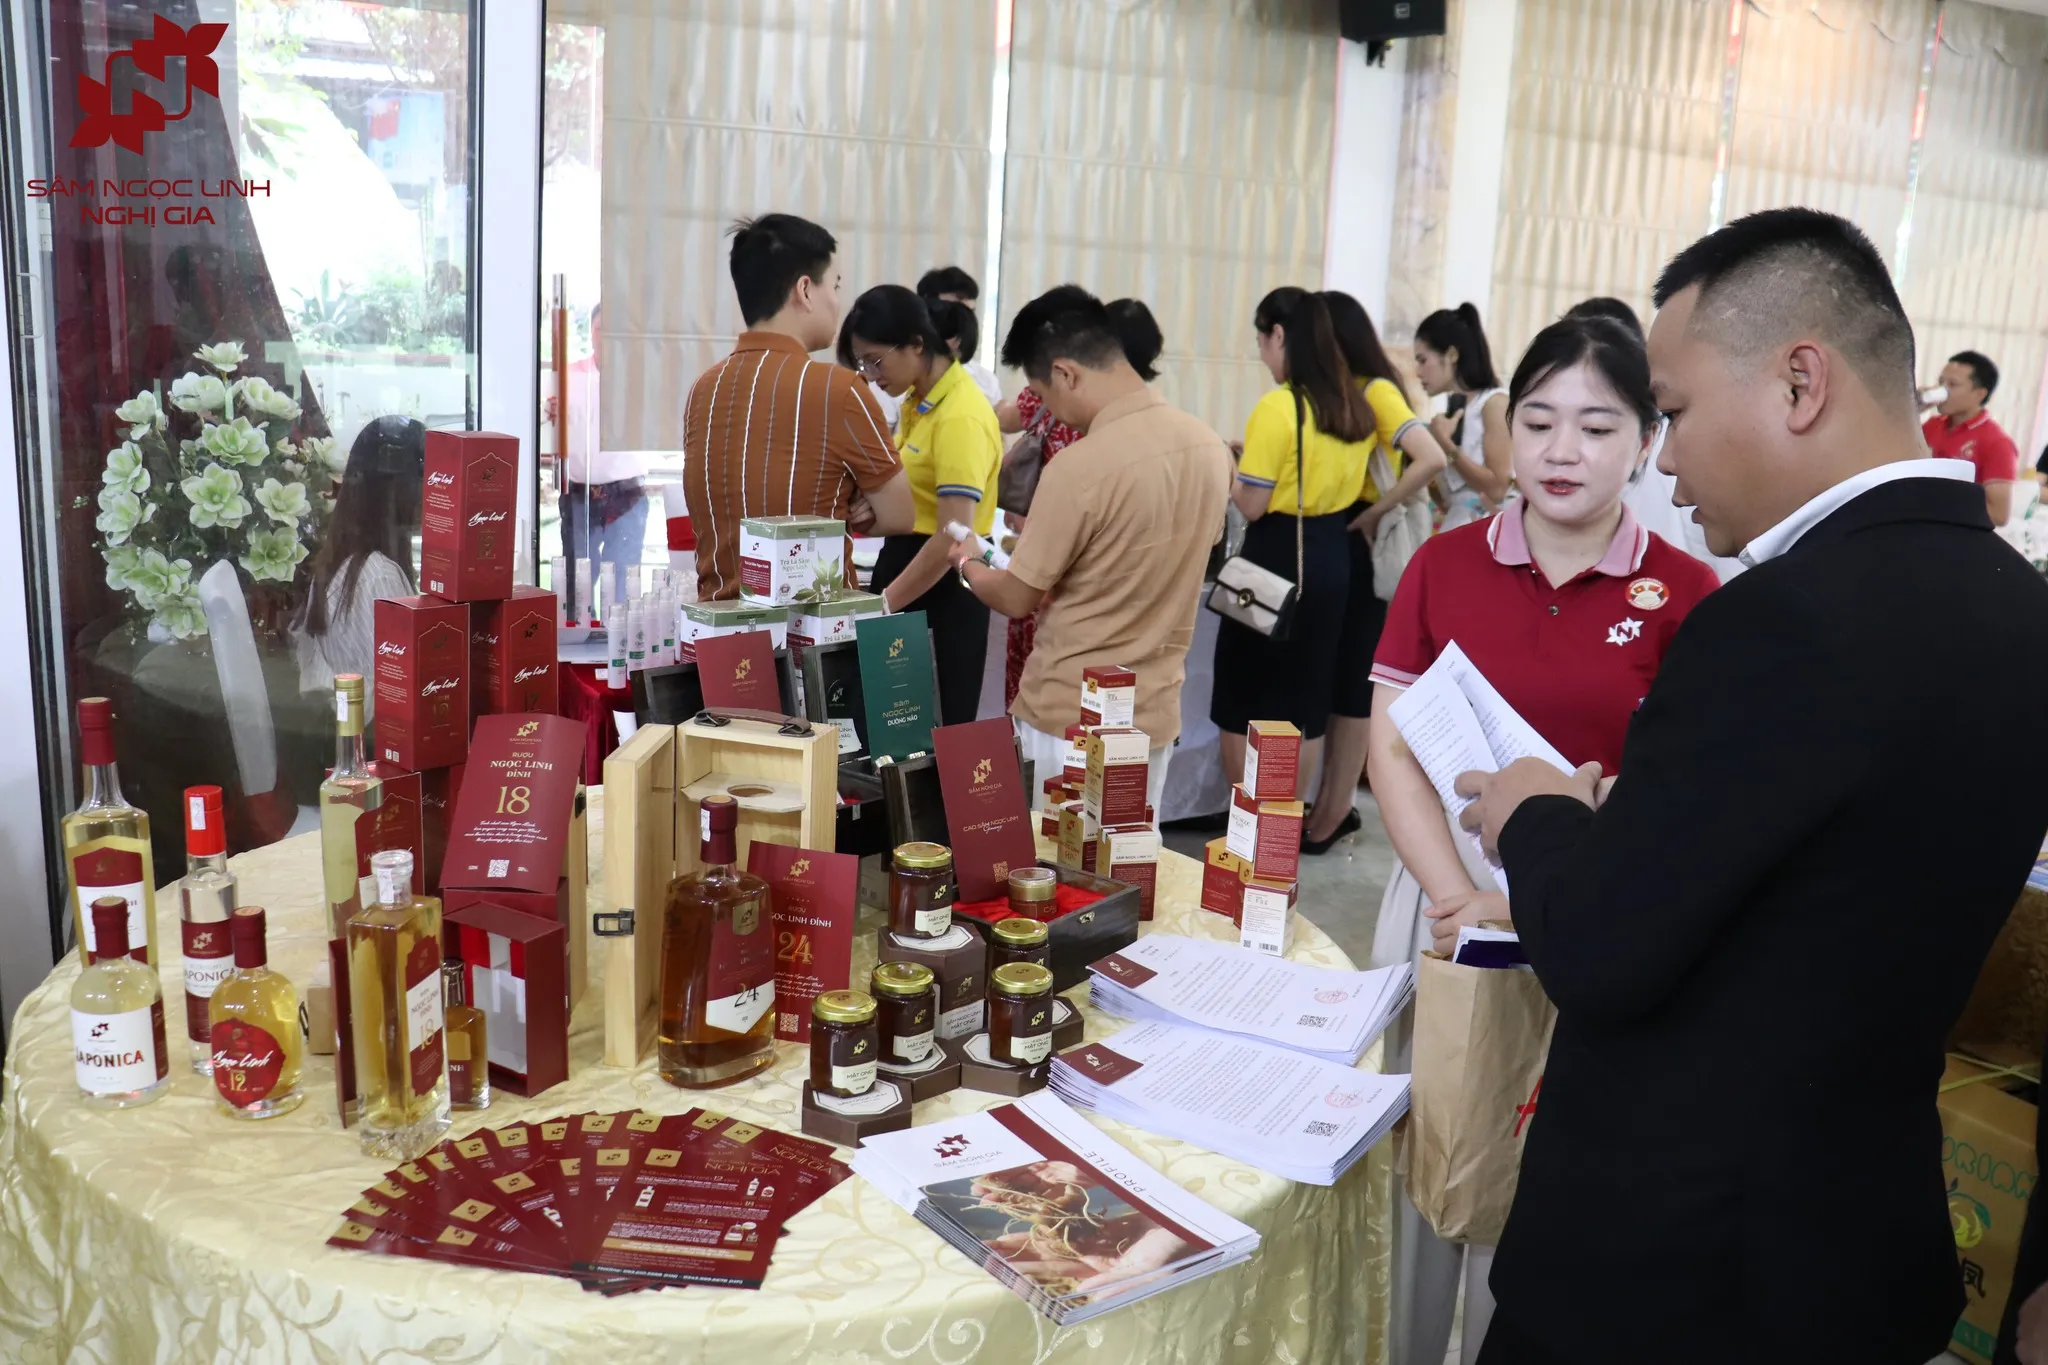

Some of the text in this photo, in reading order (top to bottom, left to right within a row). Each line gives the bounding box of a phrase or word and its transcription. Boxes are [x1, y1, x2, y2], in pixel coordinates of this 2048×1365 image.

[524, 760, 553, 770] LINH
[495, 785, 531, 815] 18
[777, 931, 814, 965] 24
[230, 1070, 247, 1092] 12
[1084, 1151, 1147, 1193] PROFILE
